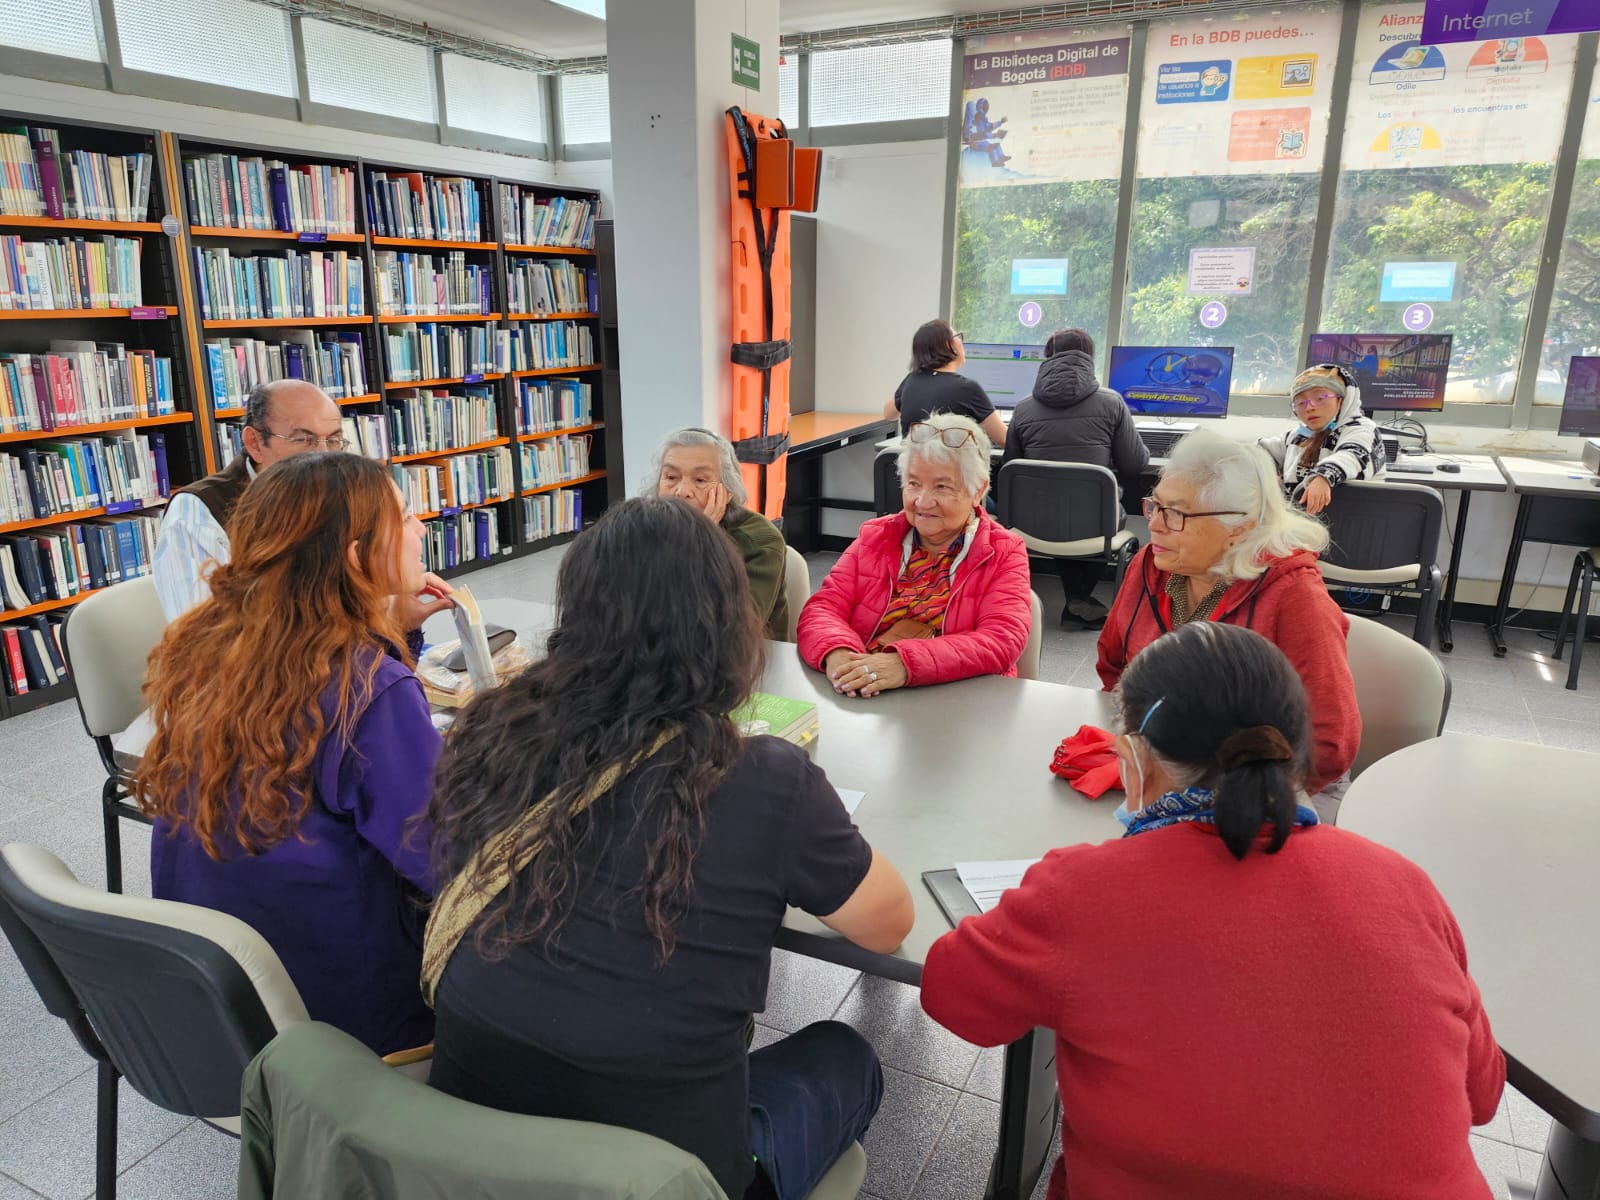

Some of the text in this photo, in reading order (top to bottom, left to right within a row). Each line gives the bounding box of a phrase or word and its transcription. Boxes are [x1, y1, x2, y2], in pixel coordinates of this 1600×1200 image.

[1378, 14, 1424, 27] Alianz
[1442, 8, 1534, 32] Internet
[1170, 26, 1315, 47] En la BDB puedes...
[1379, 32, 1422, 42] Descubr
[974, 44, 1119, 71] La Biblioteca Digital de
[1001, 63, 1087, 83] Bogotá (BDB)
[1467, 103, 1513, 113] encuentras
[1026, 308, 1034, 321] 1
[1207, 307, 1220, 321] 2
[1411, 309, 1425, 325] 3
